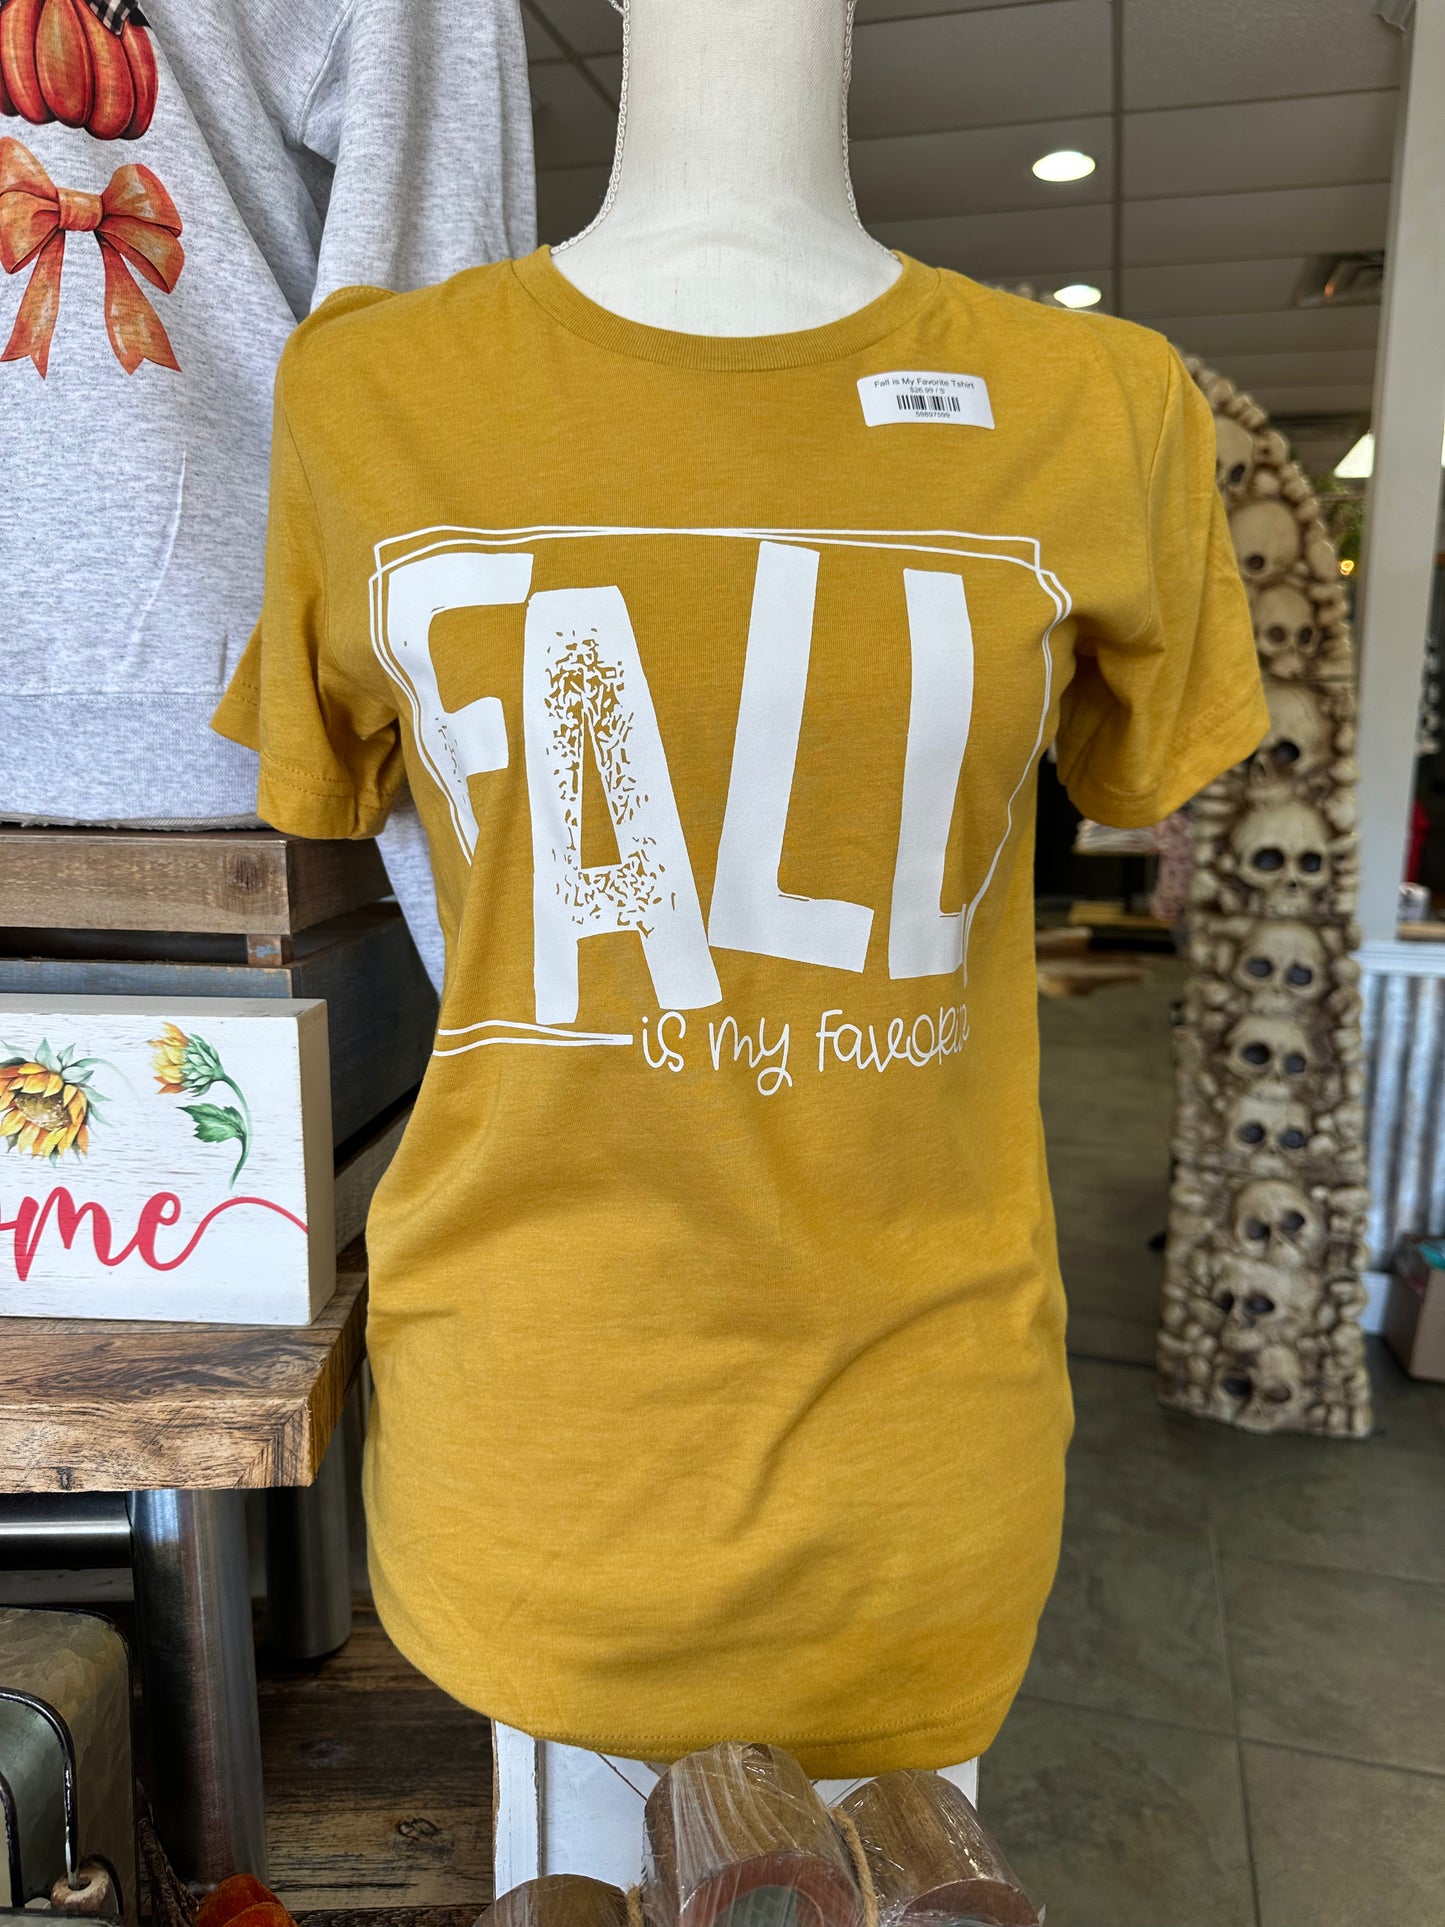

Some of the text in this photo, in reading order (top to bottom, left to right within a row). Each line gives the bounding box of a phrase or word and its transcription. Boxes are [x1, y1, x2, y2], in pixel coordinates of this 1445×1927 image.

[874, 379, 890, 388] Fall
[902, 378, 914, 387] My
[916, 378, 949, 387] Favorite
[951, 380, 975, 390] Tshirt
[386, 541, 975, 1024] FALL
[642, 1011, 686, 1072] is
[709, 1016, 793, 1096] my
[0, 1186, 308, 1281] me
